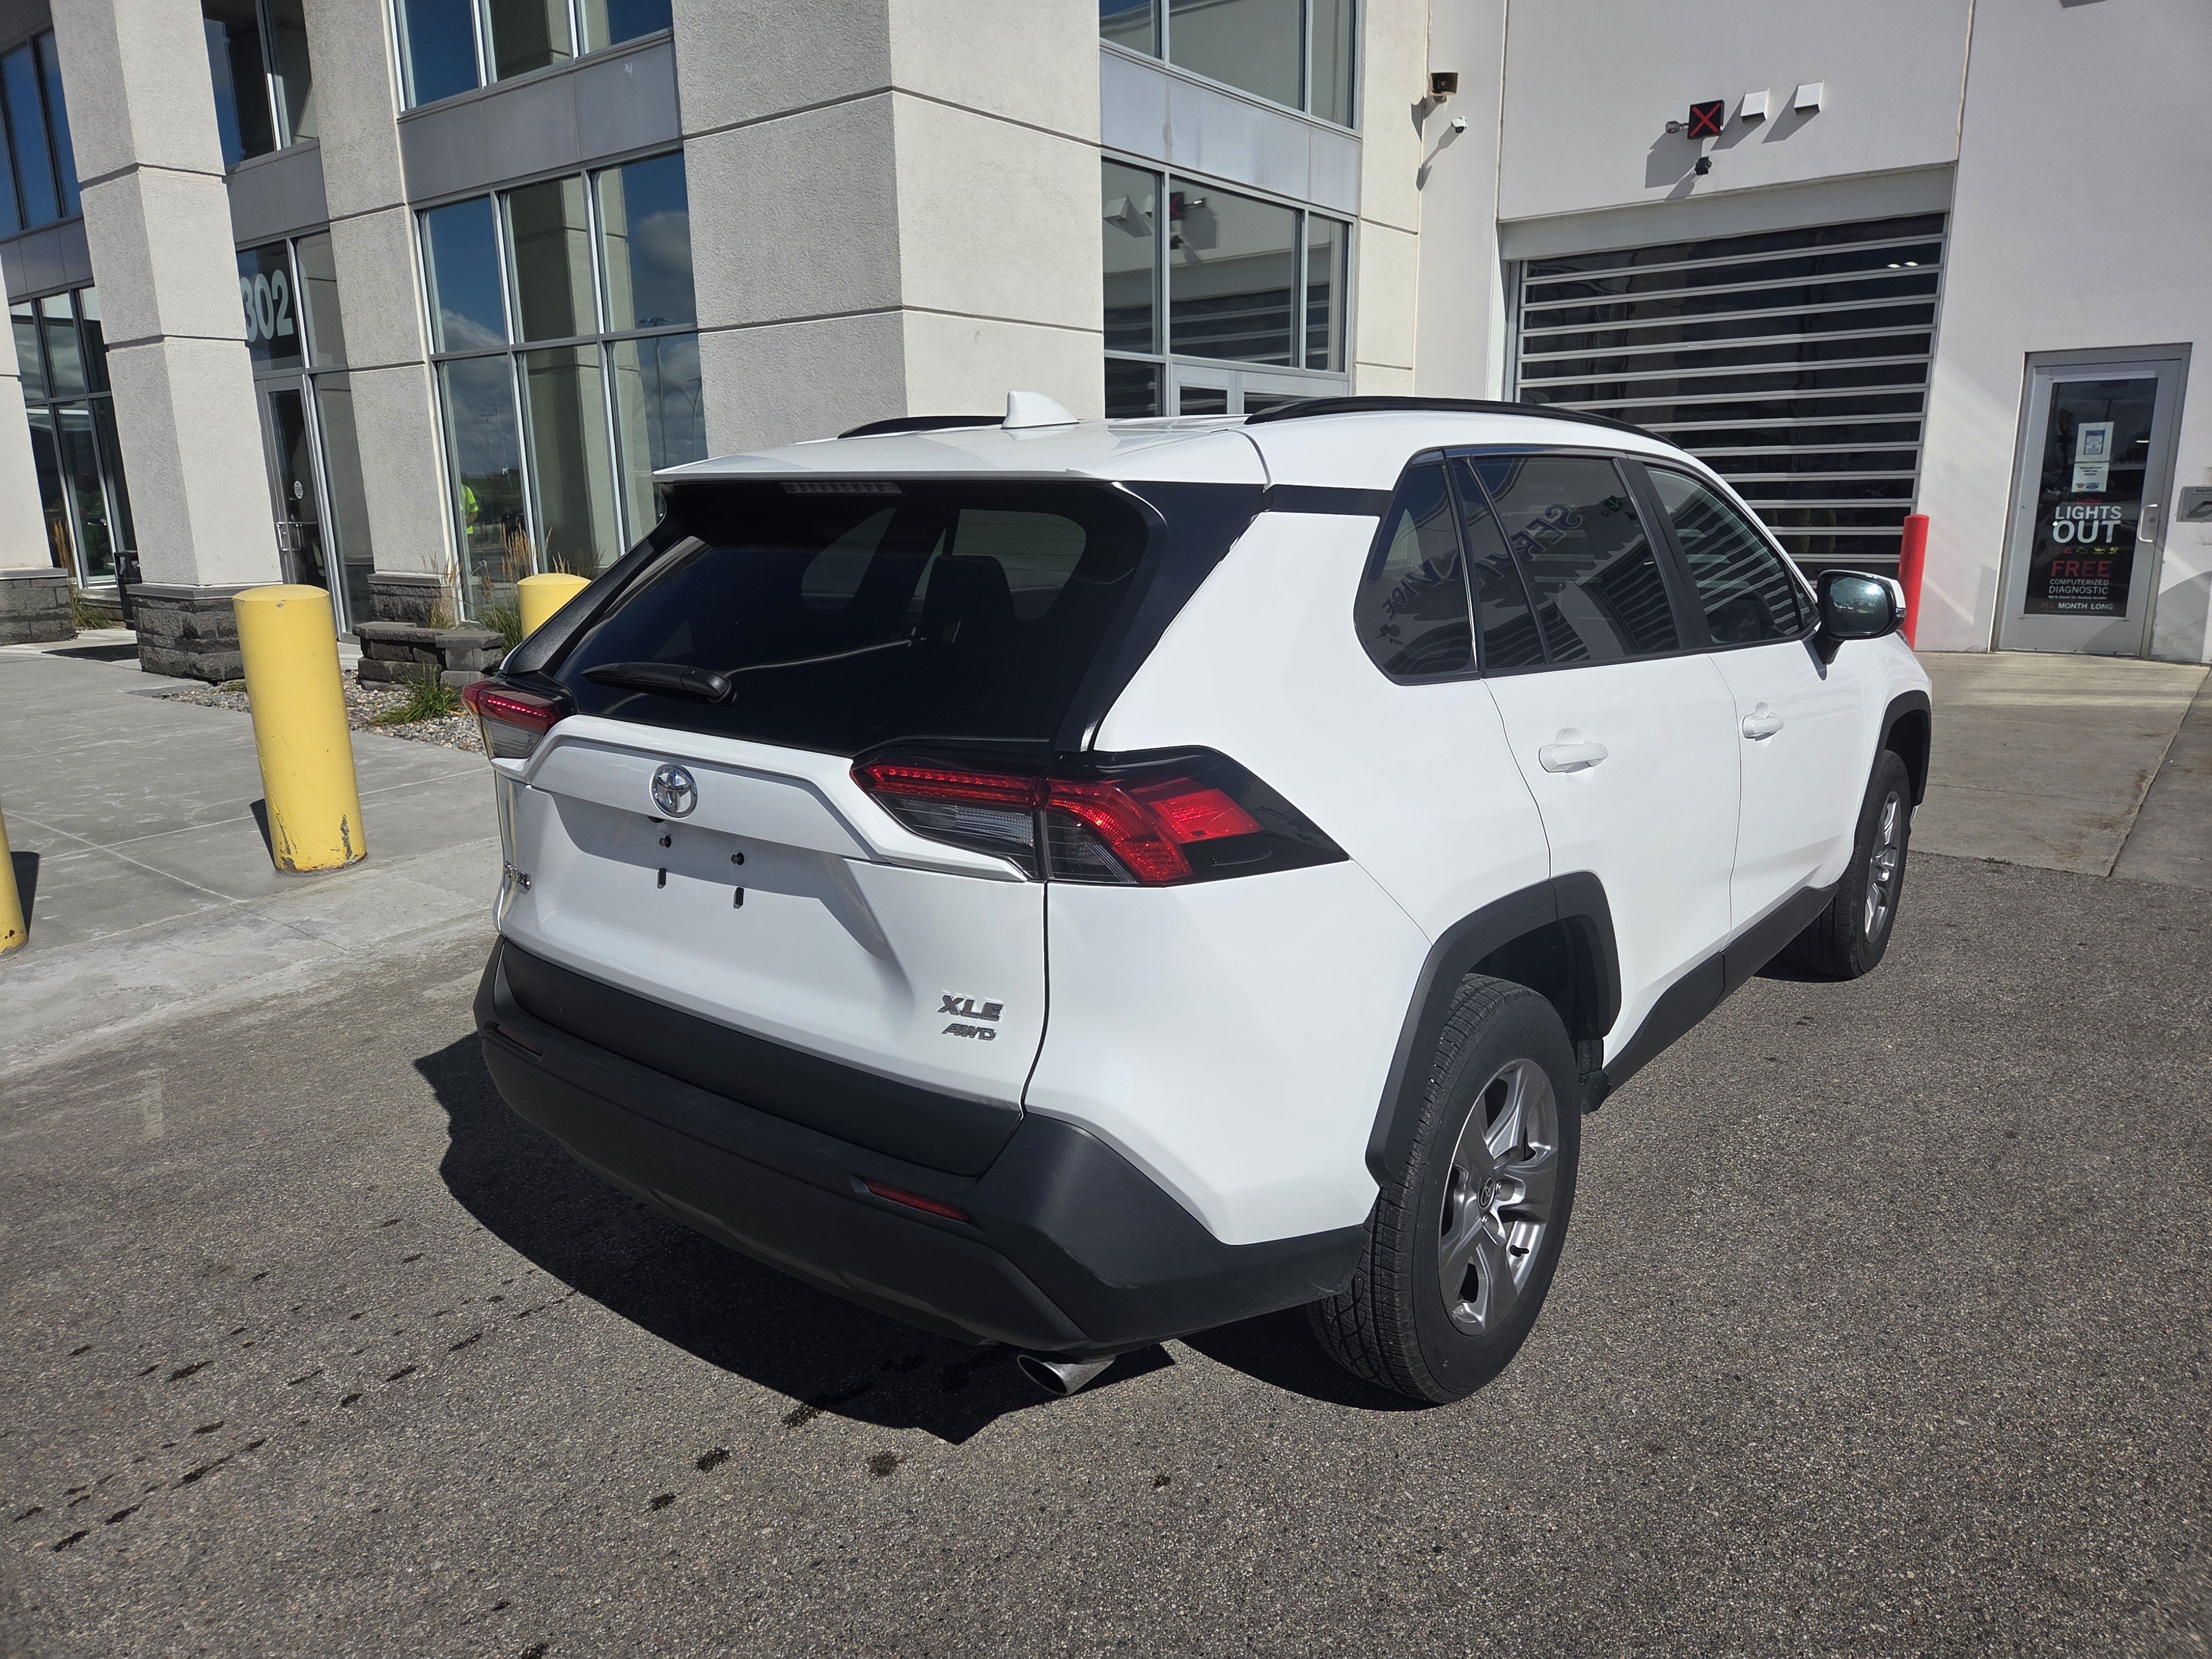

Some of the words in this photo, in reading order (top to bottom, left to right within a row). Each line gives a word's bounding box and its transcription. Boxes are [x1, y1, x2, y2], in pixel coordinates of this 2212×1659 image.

[239, 269, 294, 342] 302
[2055, 505, 2122, 519] LIGHTS
[2053, 520, 2121, 543] OUT
[2051, 560, 2111, 577] FREE
[2049, 586, 2109, 594] DIAGNOSTIC
[937, 995, 1004, 1021] XLE
[941, 1023, 997, 1041] AWD
